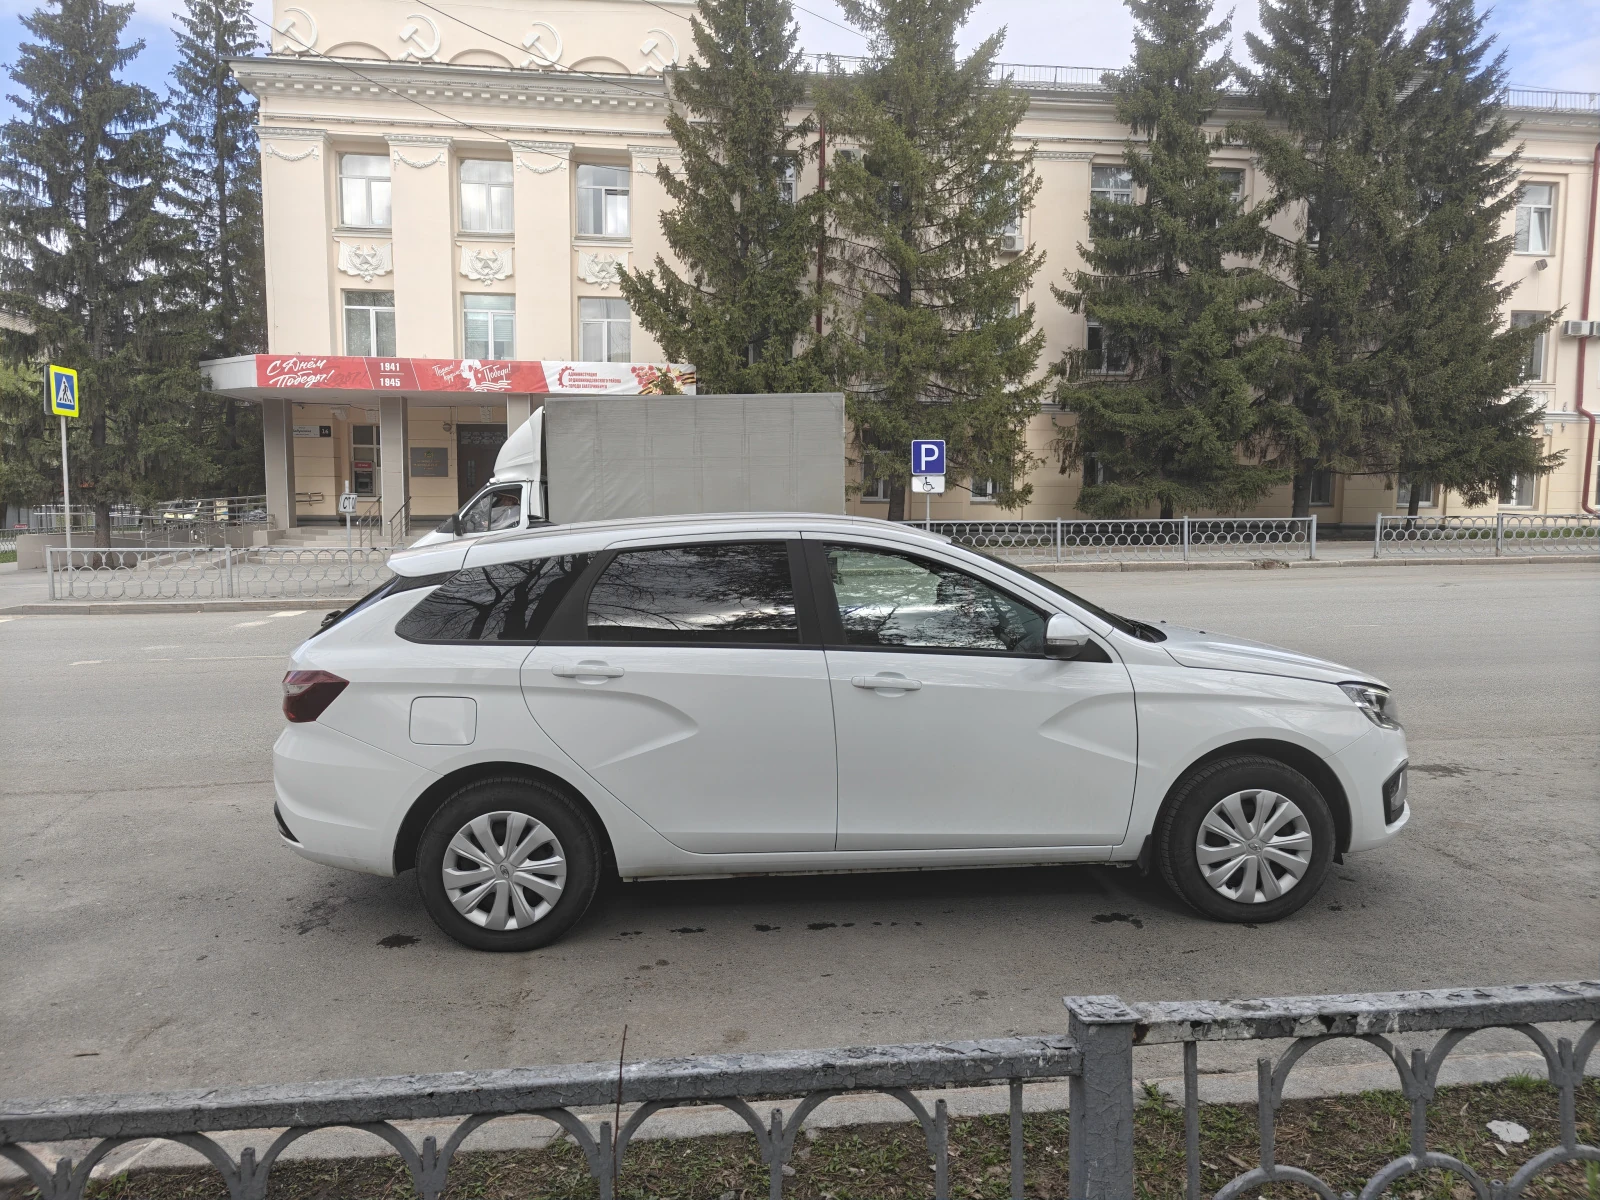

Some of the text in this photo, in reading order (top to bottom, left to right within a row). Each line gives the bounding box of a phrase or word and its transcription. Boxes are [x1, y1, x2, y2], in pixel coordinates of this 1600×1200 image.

[266, 357, 327, 376] С Днём
[379, 362, 400, 371] 1941
[479, 363, 511, 382] Победа!
[269, 370, 335, 388] Победы!
[379, 377, 401, 387] 1945
[921, 444, 939, 471] P
